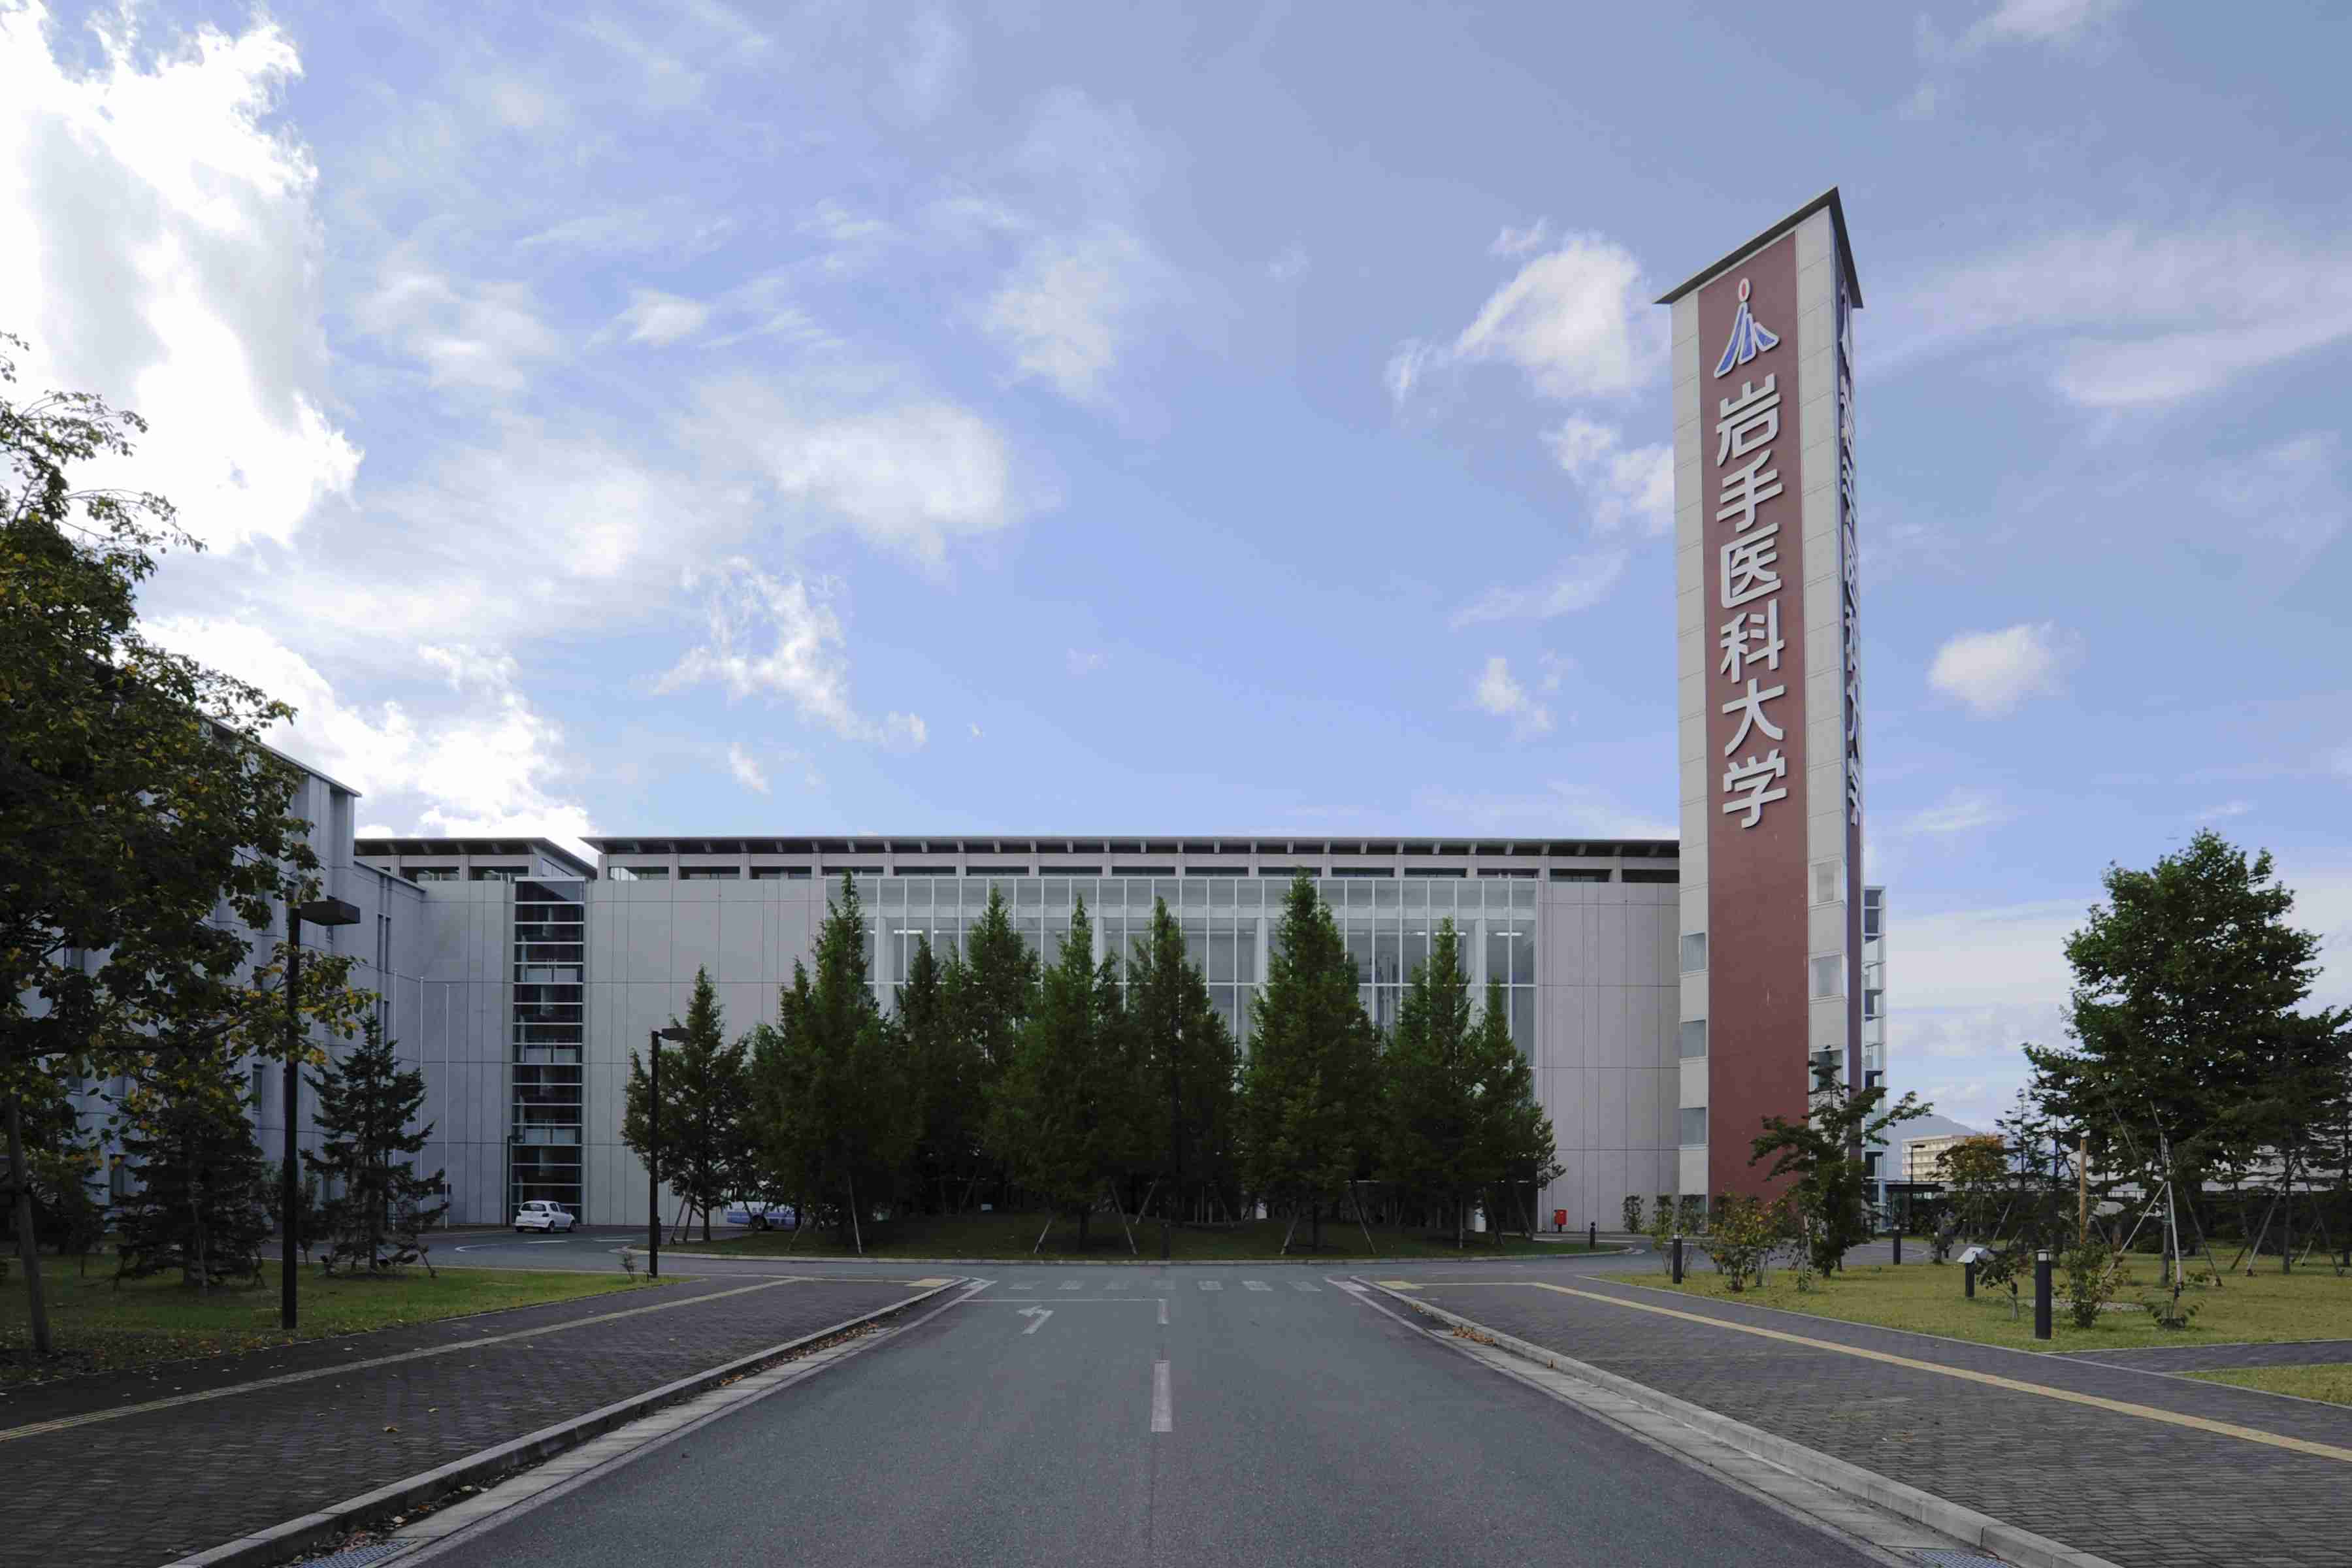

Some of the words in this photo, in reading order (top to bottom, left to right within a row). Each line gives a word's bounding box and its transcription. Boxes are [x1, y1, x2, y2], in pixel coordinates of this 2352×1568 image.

[1716, 372, 1788, 828] 岩手医科大学
